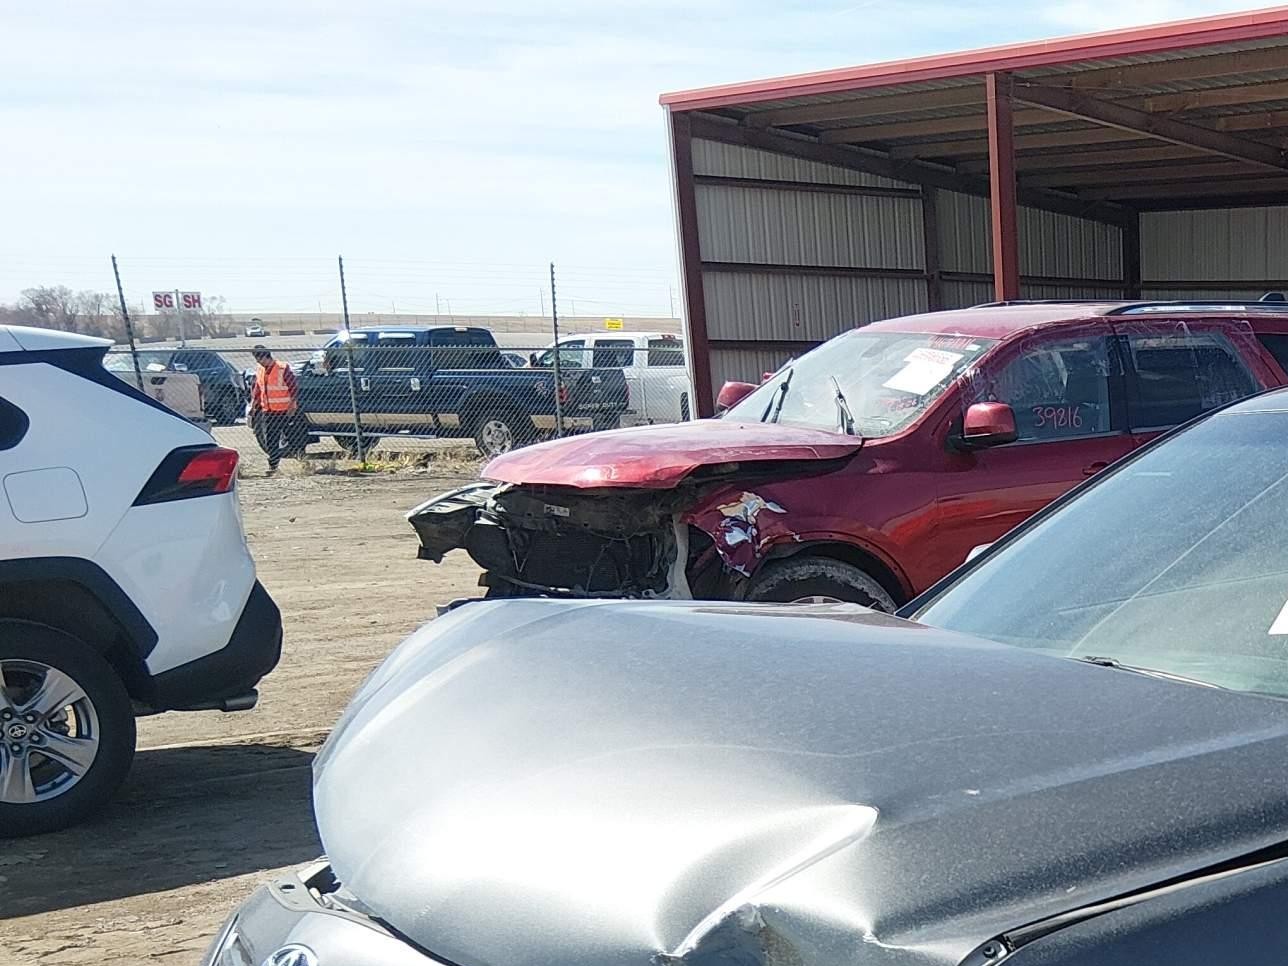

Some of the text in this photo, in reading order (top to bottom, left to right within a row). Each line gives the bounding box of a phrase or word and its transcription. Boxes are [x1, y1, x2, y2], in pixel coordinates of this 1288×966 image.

[154, 294, 174, 308] SG
[183, 294, 201, 308] SH
[1032, 406, 1082, 429] 39816
